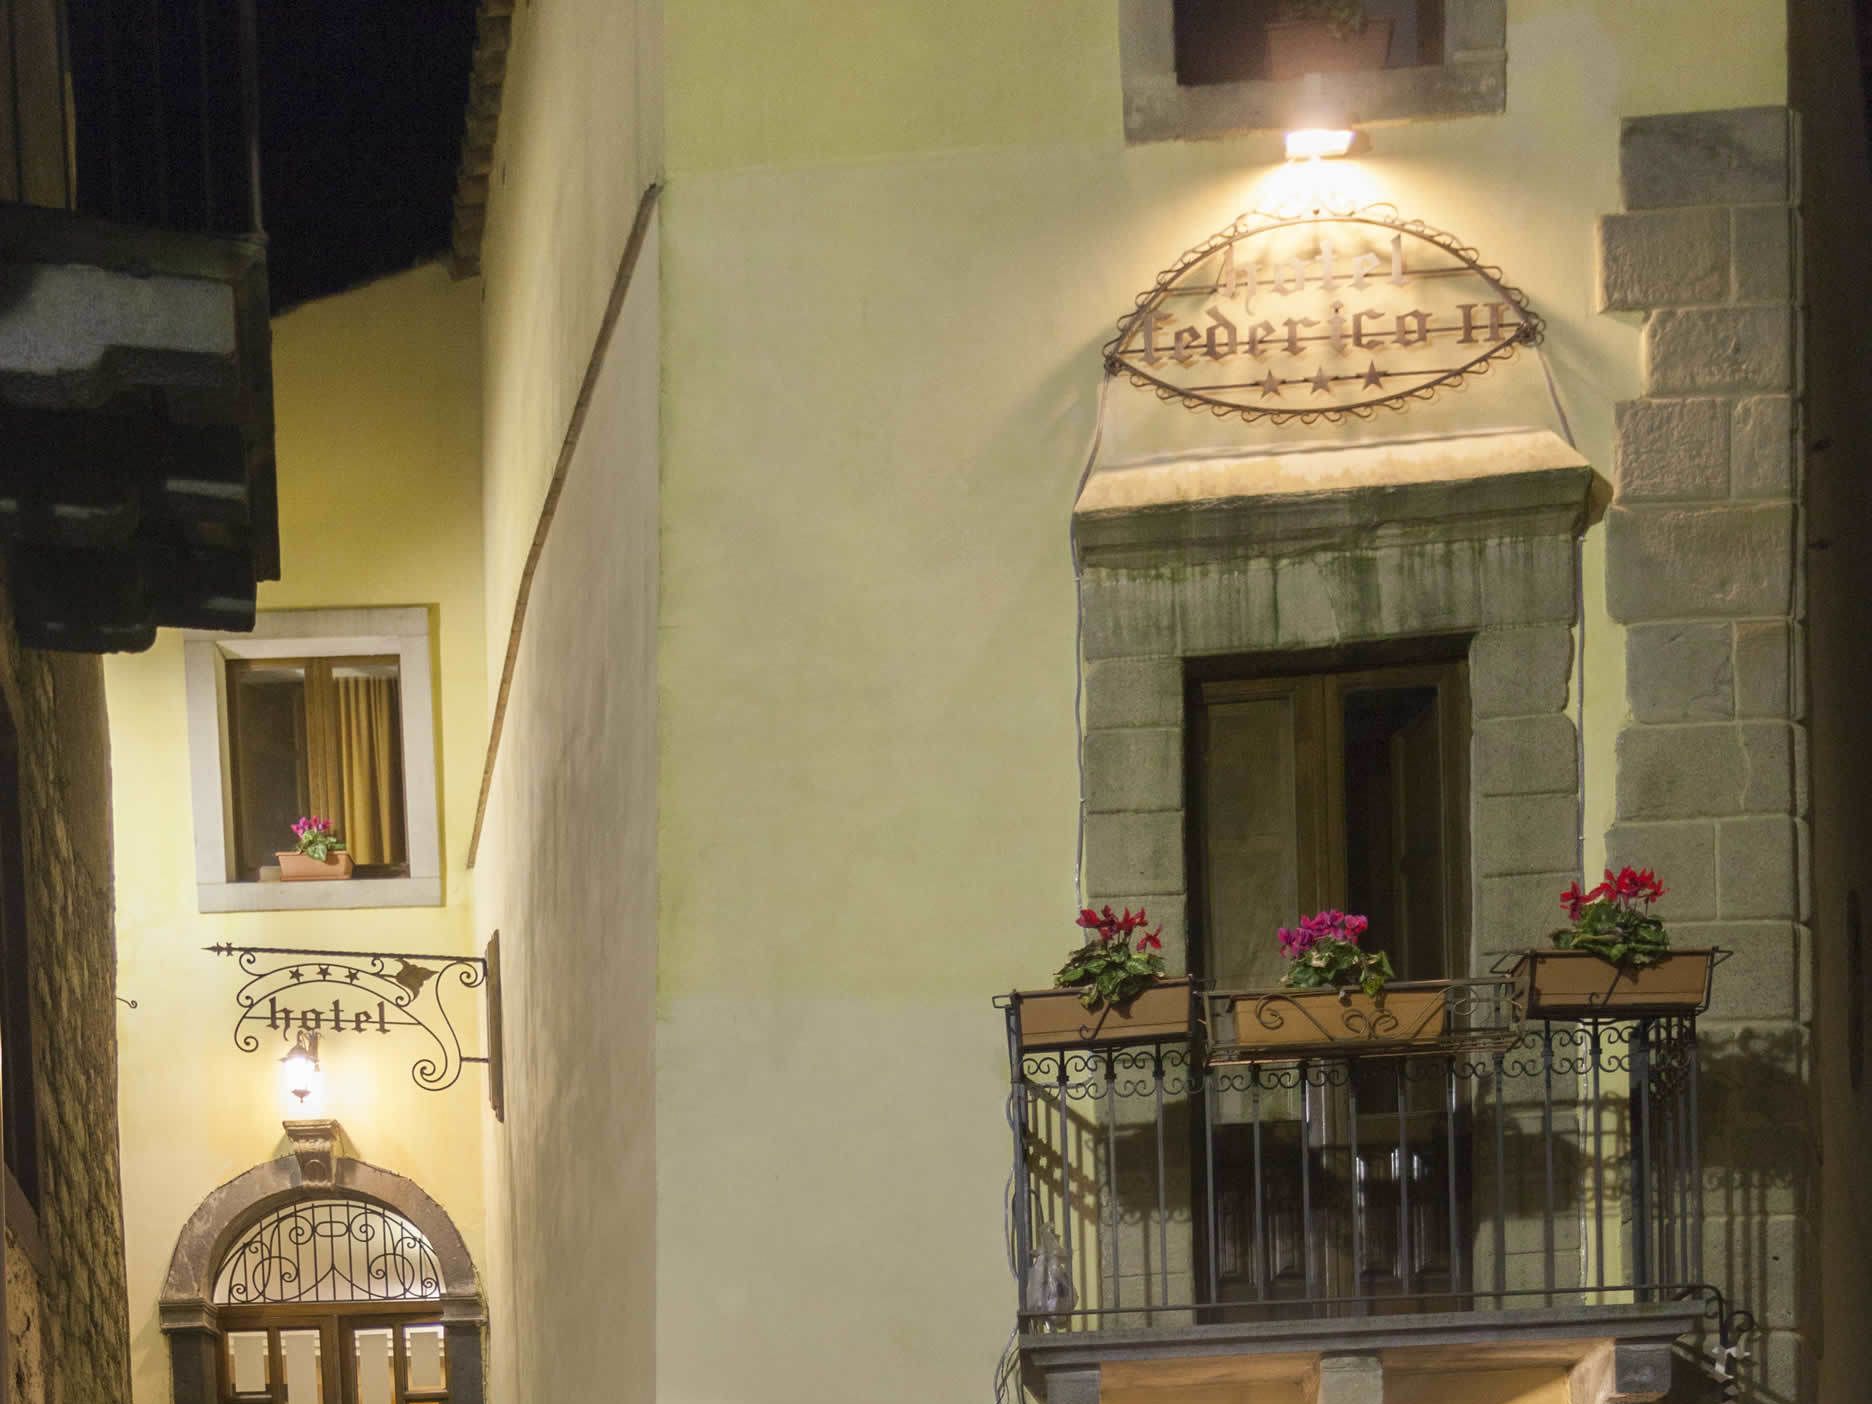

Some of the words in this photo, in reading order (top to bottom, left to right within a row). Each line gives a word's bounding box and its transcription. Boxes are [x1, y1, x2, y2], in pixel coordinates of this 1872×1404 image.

[1218, 234, 1410, 315] hotel
[1455, 302, 1512, 344] II
[265, 996, 391, 1041] hotel
